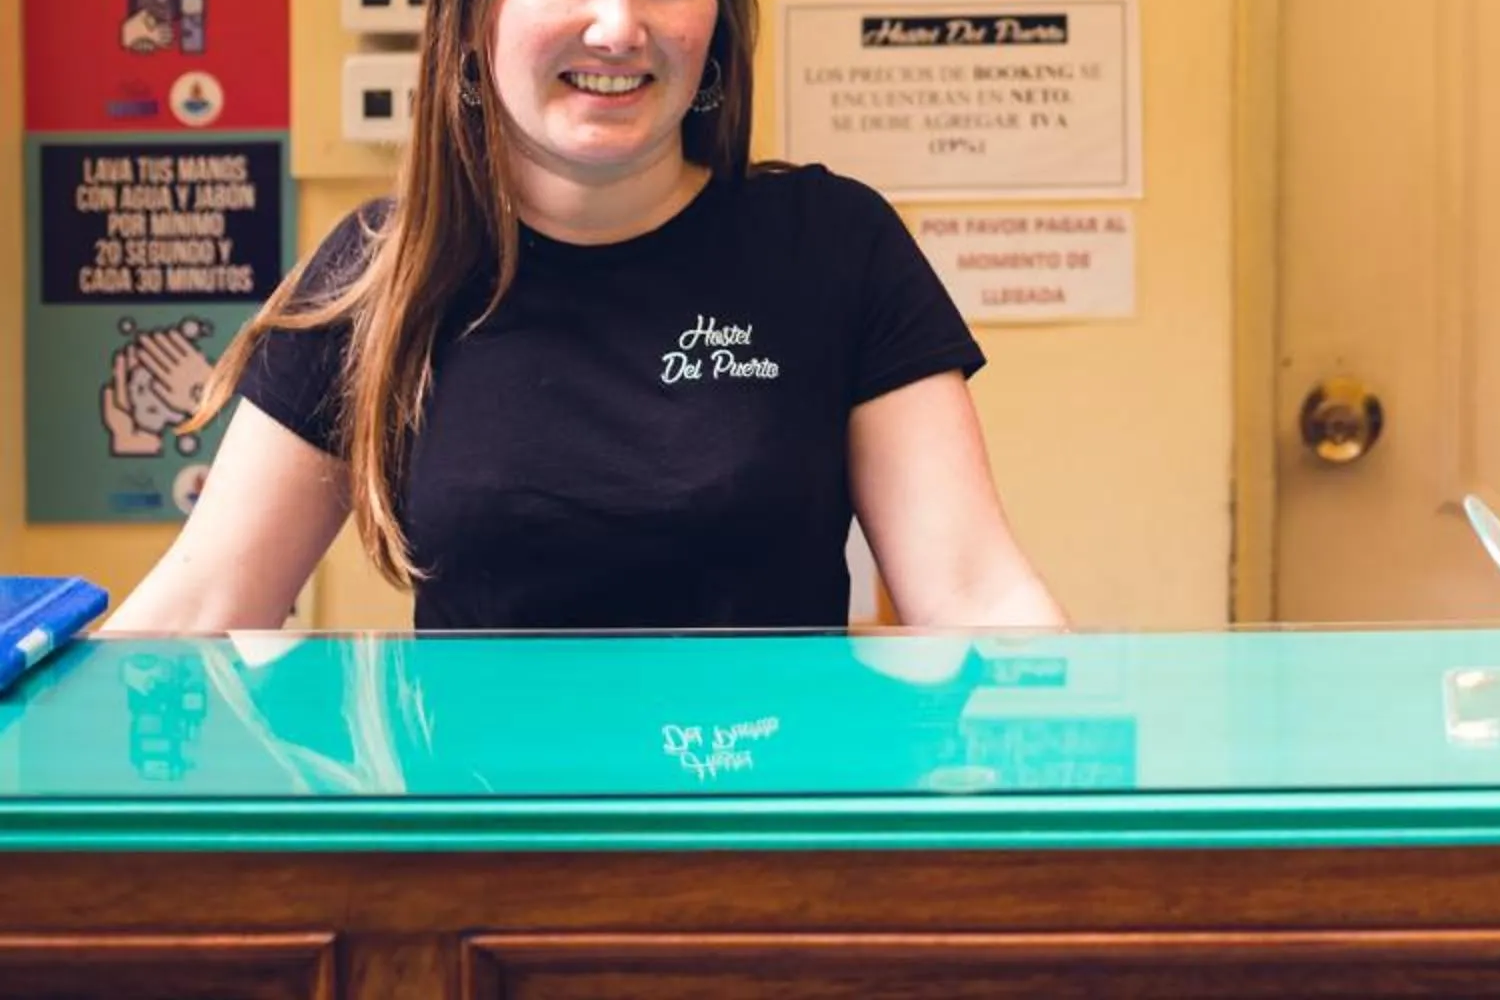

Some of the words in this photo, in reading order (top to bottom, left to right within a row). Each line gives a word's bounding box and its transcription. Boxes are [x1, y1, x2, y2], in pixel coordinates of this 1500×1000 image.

[939, 65, 965, 83] DE
[972, 63, 1074, 82] BOOKING
[1029, 112, 1069, 129] IVA
[82, 156, 134, 184] LAVA
[137, 156, 175, 184] TUS
[177, 154, 248, 184] MANOS
[76, 184, 117, 212] CON
[119, 183, 174, 212] AGUA
[175, 183, 190, 212] Y
[107, 211, 147, 240] POR
[921, 218, 960, 236] POR
[966, 217, 1028, 235] FAVOR
[94, 238, 123, 268] 20
[218, 236, 233, 266] Y
[79, 265, 134, 296] CADA
[135, 264, 164, 295] 30
[165, 263, 255, 295] MINUTOS
[679, 313, 753, 350] Hostel
[661, 351, 702, 384] Del
[710, 349, 779, 379] Puerto
